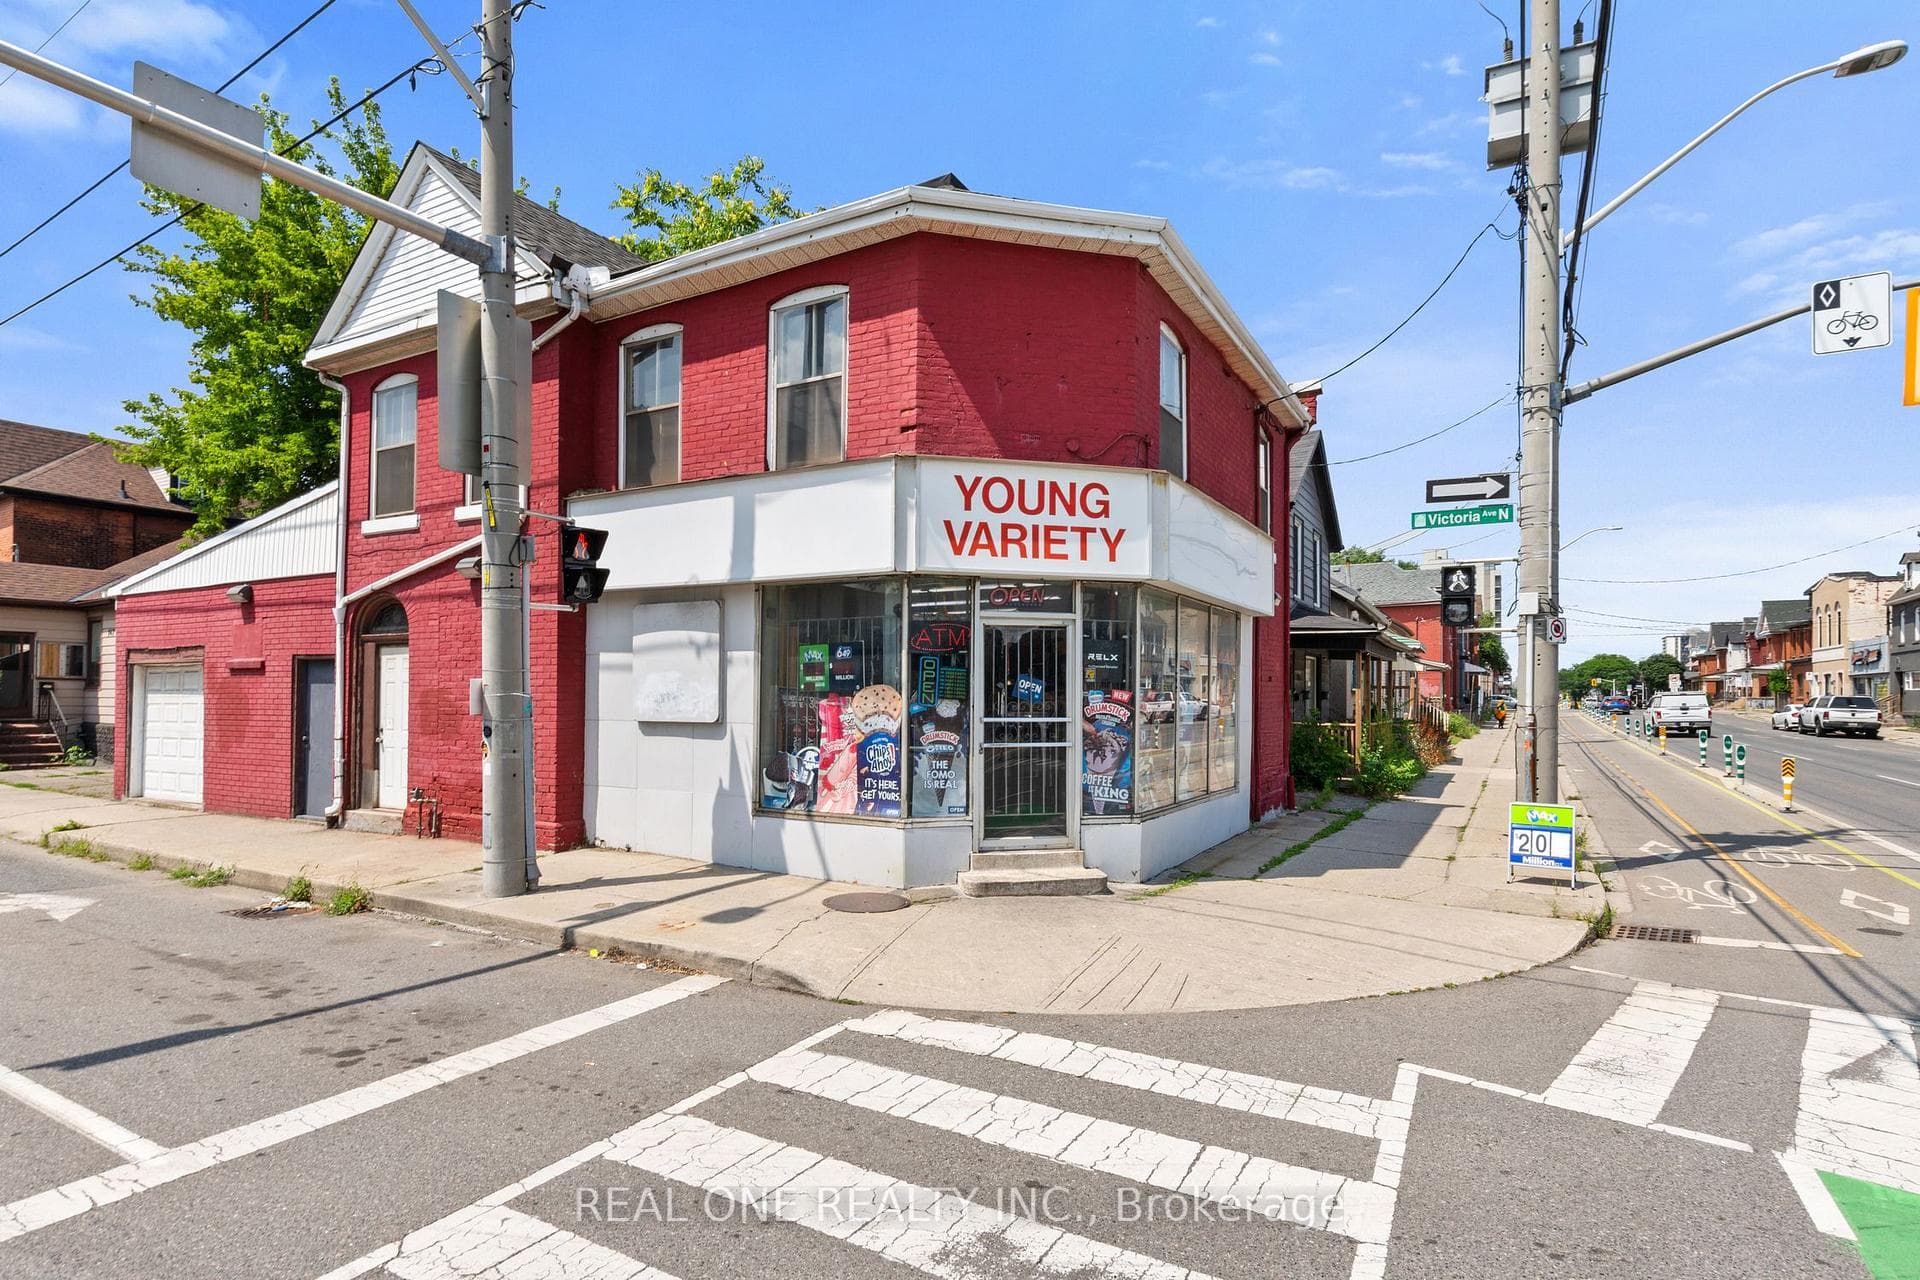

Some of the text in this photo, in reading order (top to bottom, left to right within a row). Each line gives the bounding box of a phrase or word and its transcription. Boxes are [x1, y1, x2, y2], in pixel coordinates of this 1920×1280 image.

[953, 474, 1111, 519] YOUNG
[1428, 508, 1509, 525] Victoria Ave N
[942, 519, 1127, 563] VARIETY
[990, 588, 1045, 605] OPEN
[916, 629, 966, 647] ATM
[1088, 653, 1119, 661] RELX
[922, 659, 936, 704] OPEN
[1019, 679, 1042, 694] OPEN
[1112, 691, 1130, 702] NEW
[1084, 702, 1131, 720] DRUMSTICK
[920, 731, 960, 745] DRUMSTICK
[867, 745, 891, 762] Chips
[932, 760, 949, 769] THE
[926, 771, 956, 780] FOMO
[1082, 774, 1113, 787] COFFEE
[865, 778, 877, 788] IT'S
[923, 780, 958, 789] IS REAL
[861, 789, 877, 800] GET
[1094, 786, 1129, 800] KING
[1522, 856, 1555, 866] Million
